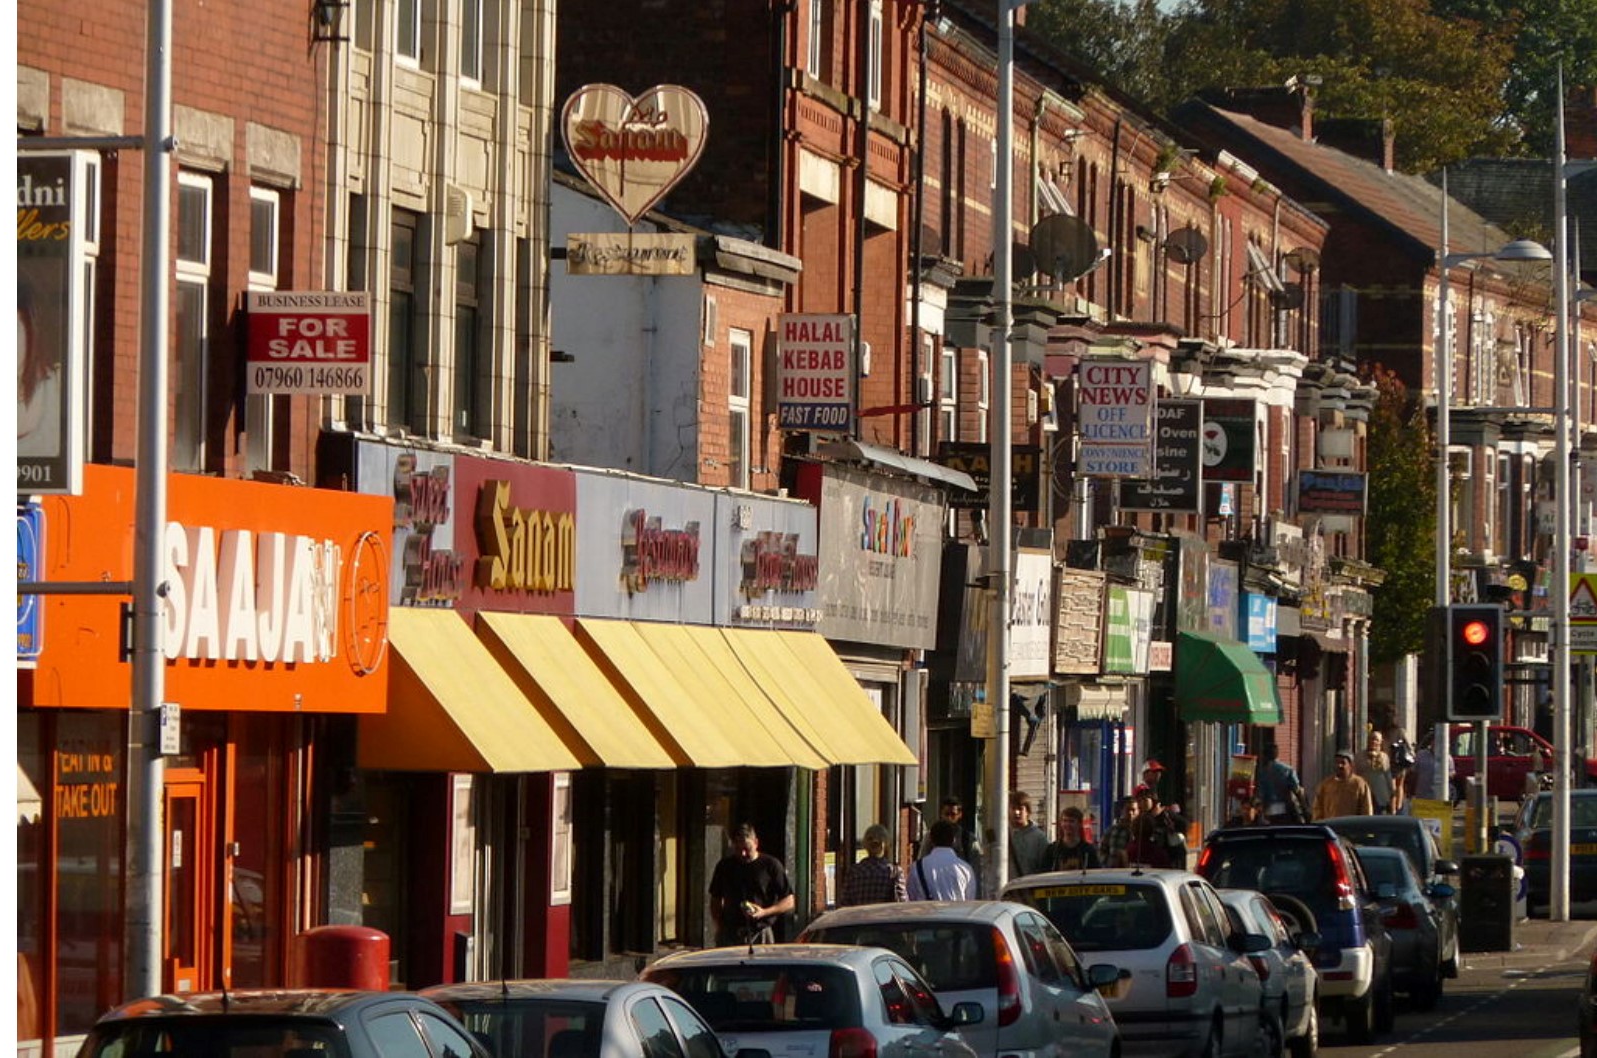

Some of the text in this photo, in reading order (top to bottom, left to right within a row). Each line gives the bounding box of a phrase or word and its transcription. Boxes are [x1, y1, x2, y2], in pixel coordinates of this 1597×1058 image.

[258, 295, 365, 308] BUSINESS LEASE
[278, 318, 348, 337] FOR
[785, 321, 844, 343] HALAL
[268, 339, 357, 359] SALE
[784, 349, 845, 370] KEBAB
[255, 366, 364, 389] 07960 146866
[1086, 365, 1142, 385] CITY
[783, 377, 845, 398] HOUSE
[1081, 387, 1147, 406] NEWS
[781, 405, 848, 426] FAST FOOD
[1097, 407, 1127, 423] OFF
[1160, 427, 1197, 438] Oven
[1086, 461, 1140, 474] STORE
[486, 480, 576, 592] Sanam
[55, 782, 118, 818] TAKE OUT
